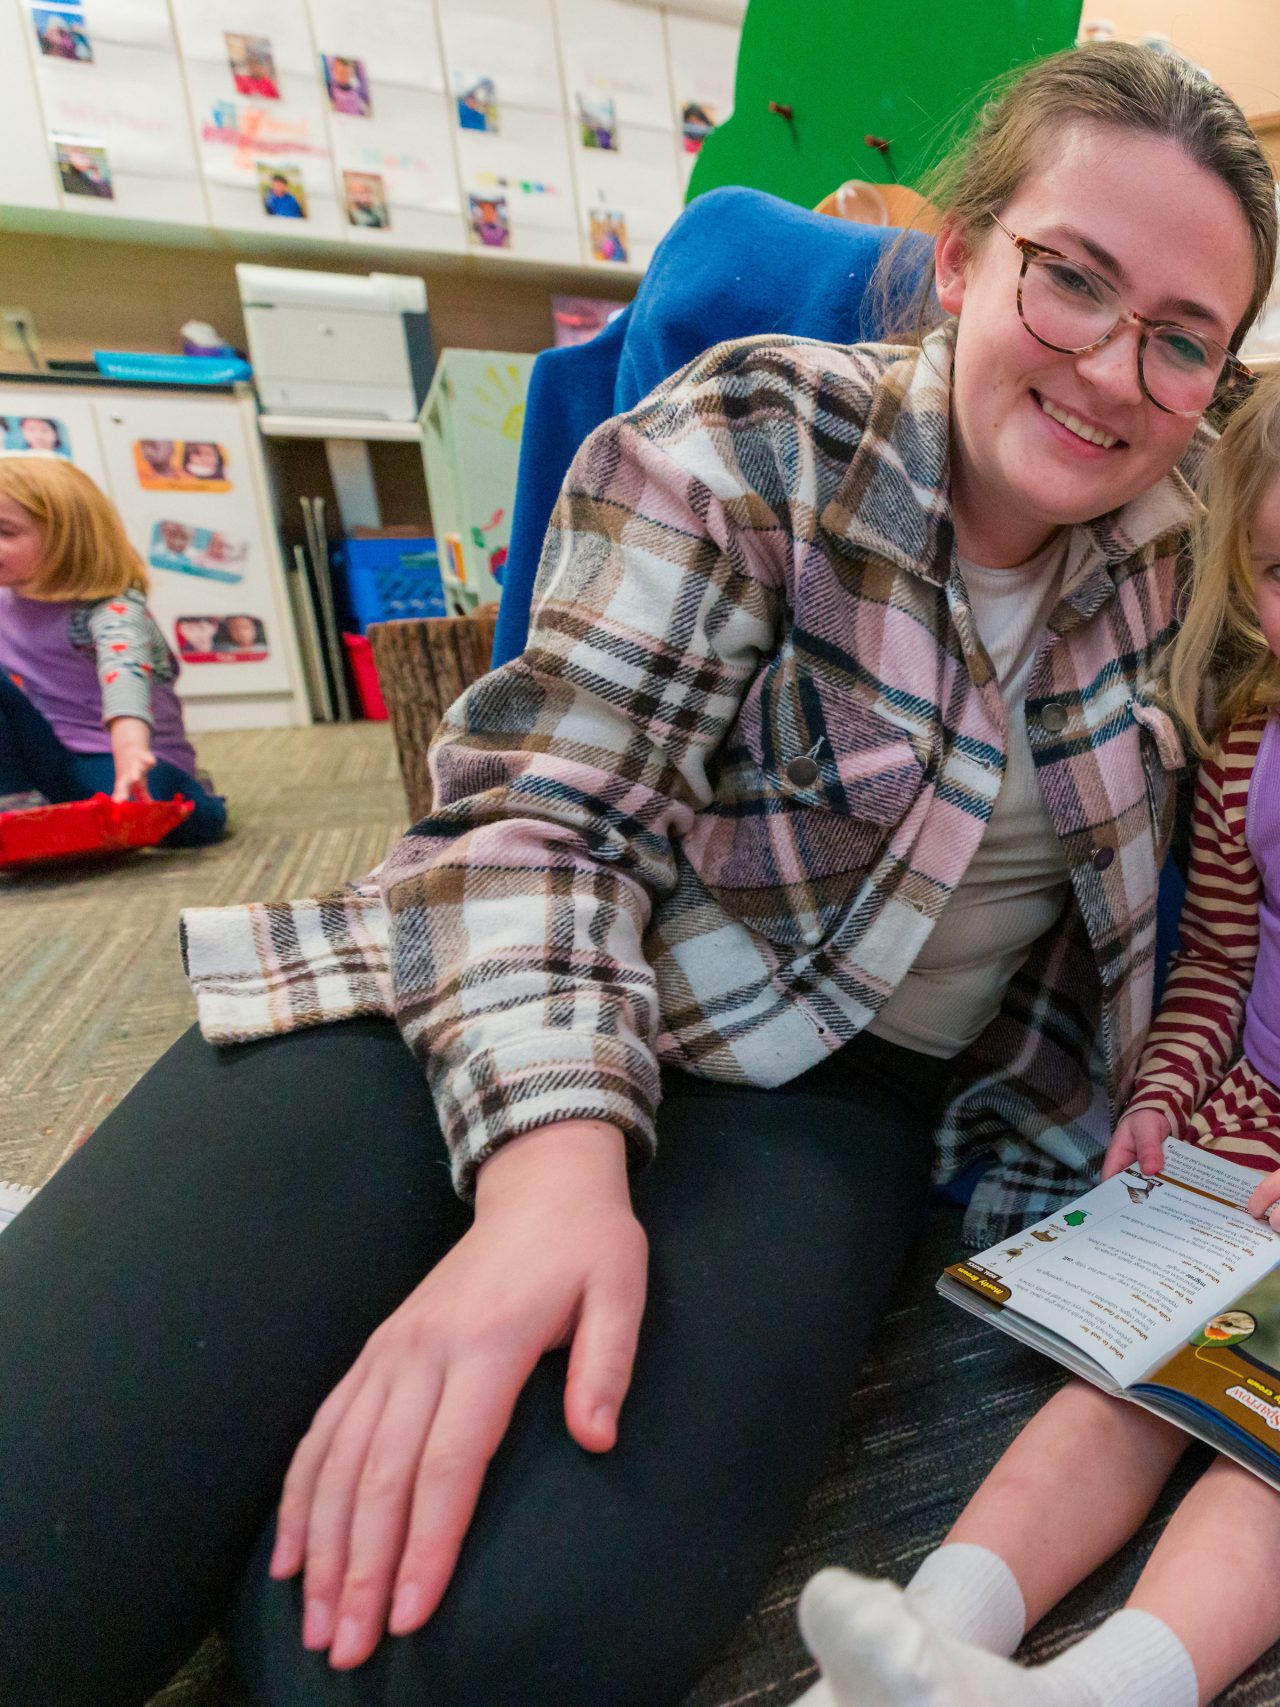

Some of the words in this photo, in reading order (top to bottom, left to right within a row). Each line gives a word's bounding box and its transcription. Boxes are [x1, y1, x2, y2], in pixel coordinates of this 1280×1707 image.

[1192, 1265, 1204, 1273] they
[1221, 1262, 1234, 1272] Nest
[957, 1267, 979, 1283] Brown
[1184, 1273, 1205, 1287] migrate
[1205, 1272, 1219, 1283] What
[979, 1278, 1001, 1295] Mostly
[1159, 1280, 1173, 1291] move
[1131, 1293, 1146, 1304] songs
[1174, 1289, 1183, 1298] the
[1185, 1296, 1192, 1304] On
[1103, 1307, 1114, 1316] find
[1146, 1302, 1156, 1311] and
[1158, 1310, 1170, 1321] Calls
[1090, 1331, 1101, 1341] look
[1130, 1323, 1147, 1340] Where
[1109, 1345, 1123, 1359] What
[1245, 1377, 1273, 1397] crown
